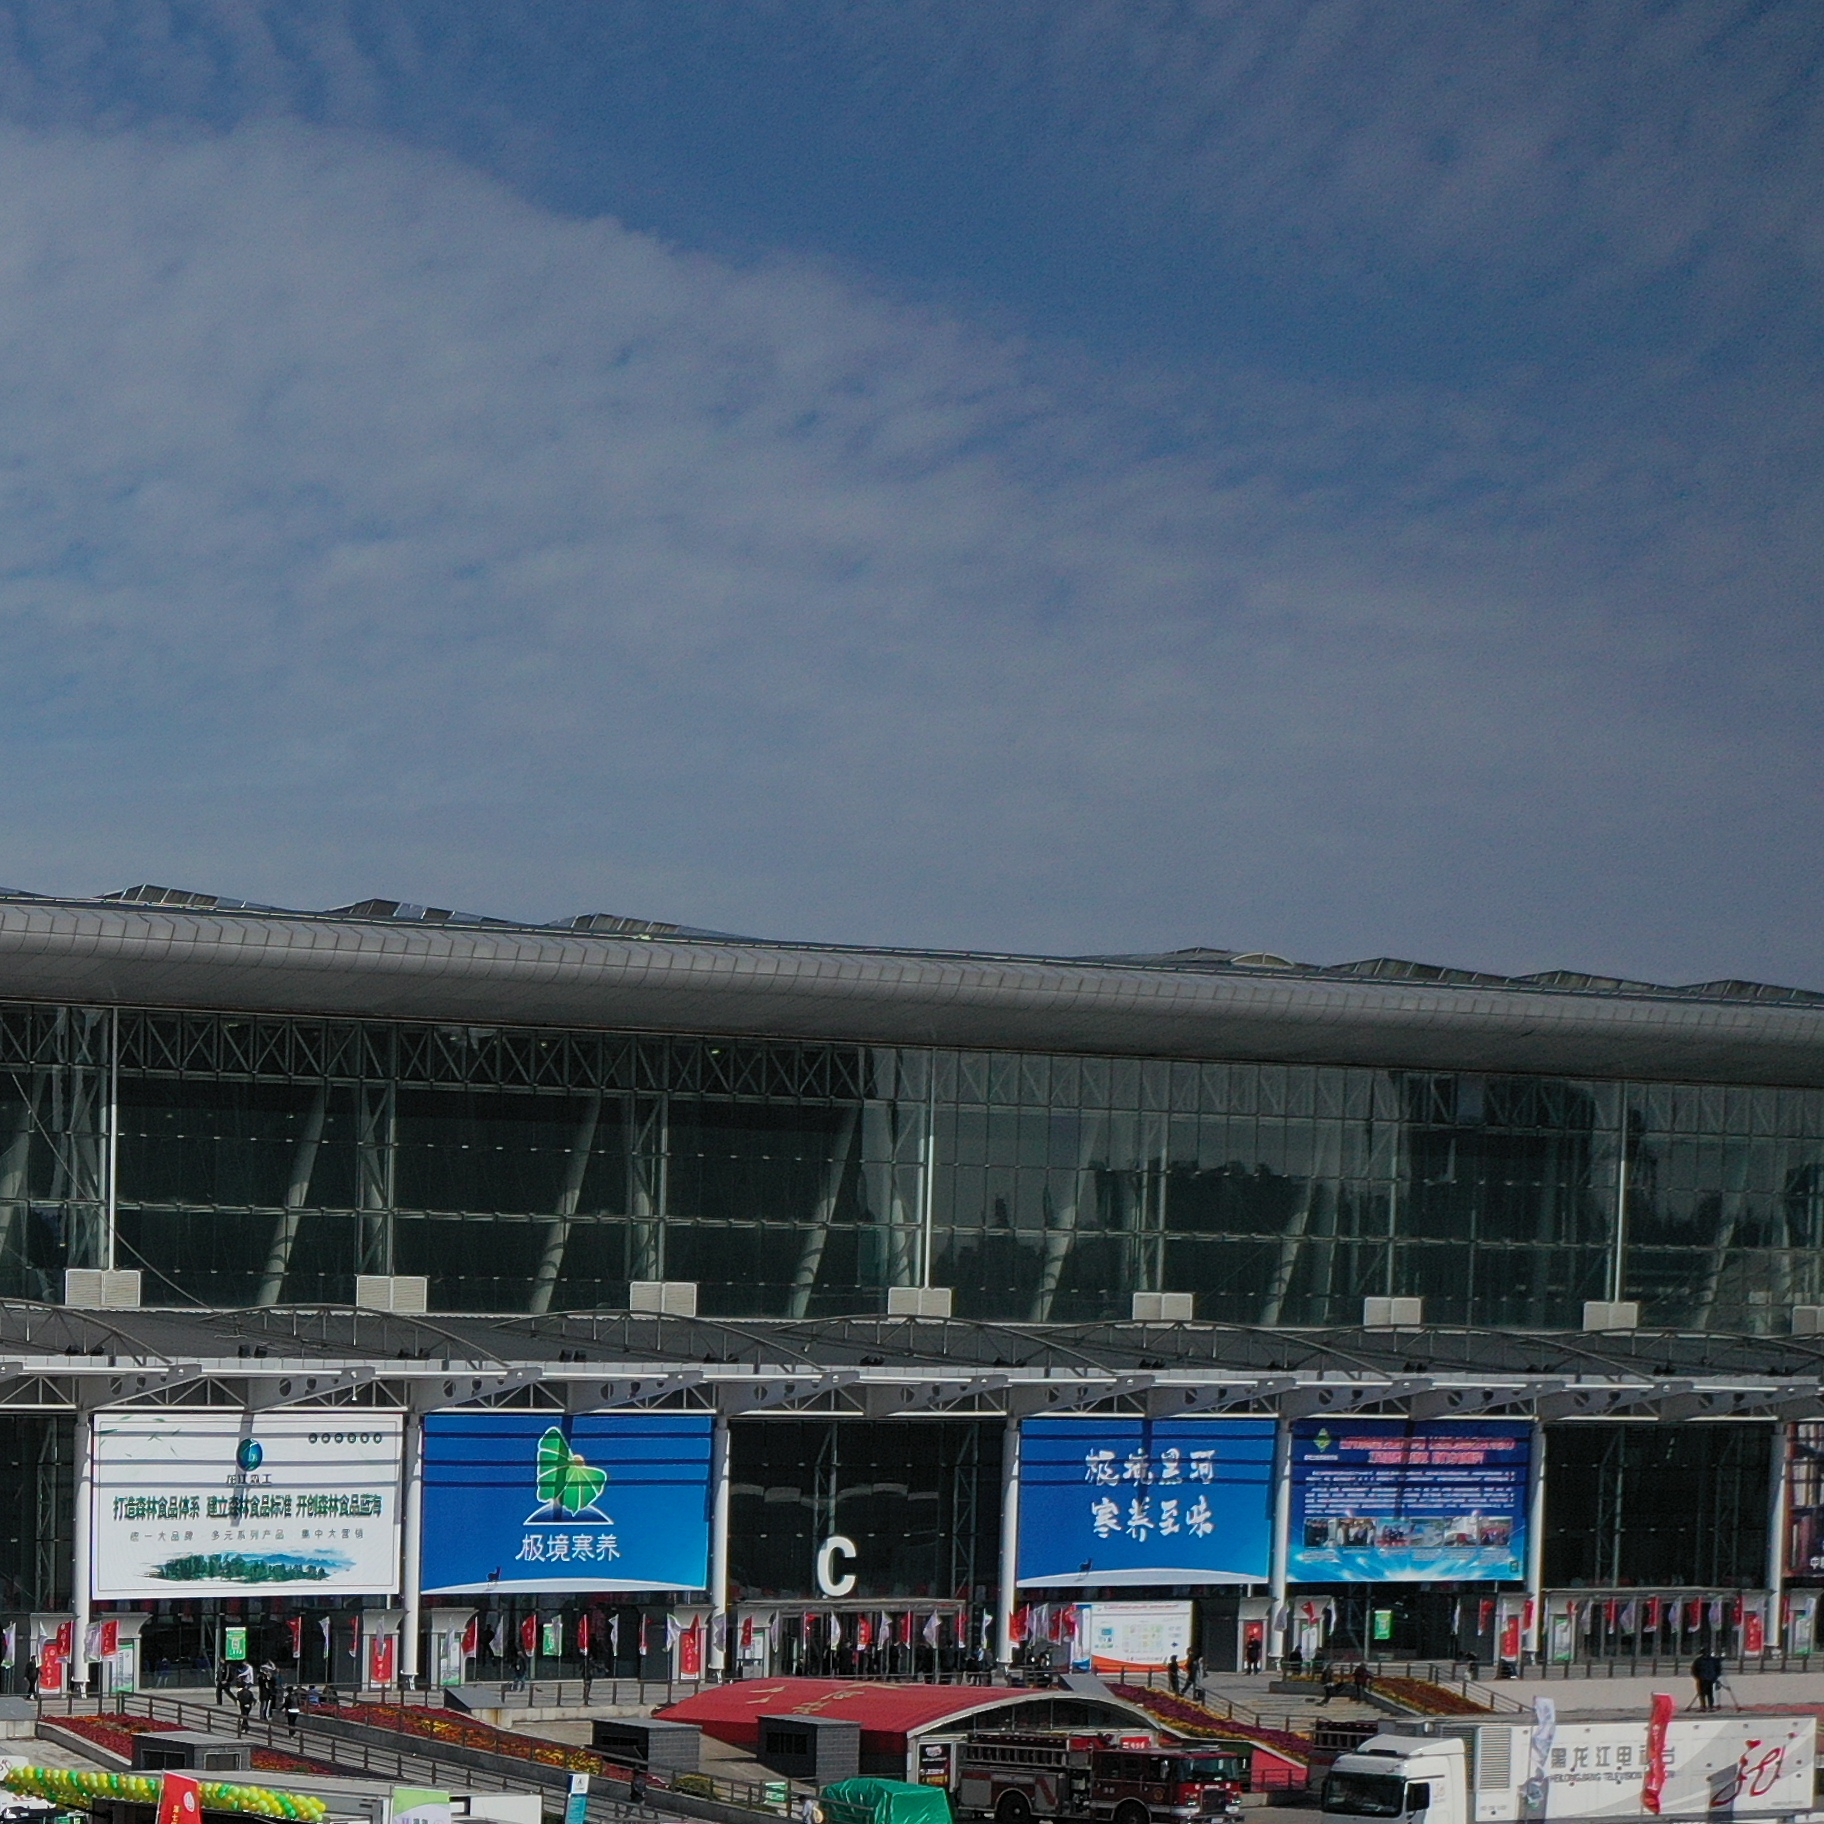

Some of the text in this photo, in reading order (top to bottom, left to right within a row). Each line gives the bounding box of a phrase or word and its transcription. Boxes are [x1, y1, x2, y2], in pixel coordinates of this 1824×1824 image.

[515, 1533, 621, 1564] 极境寒养
[816, 1534, 857, 1597] C
